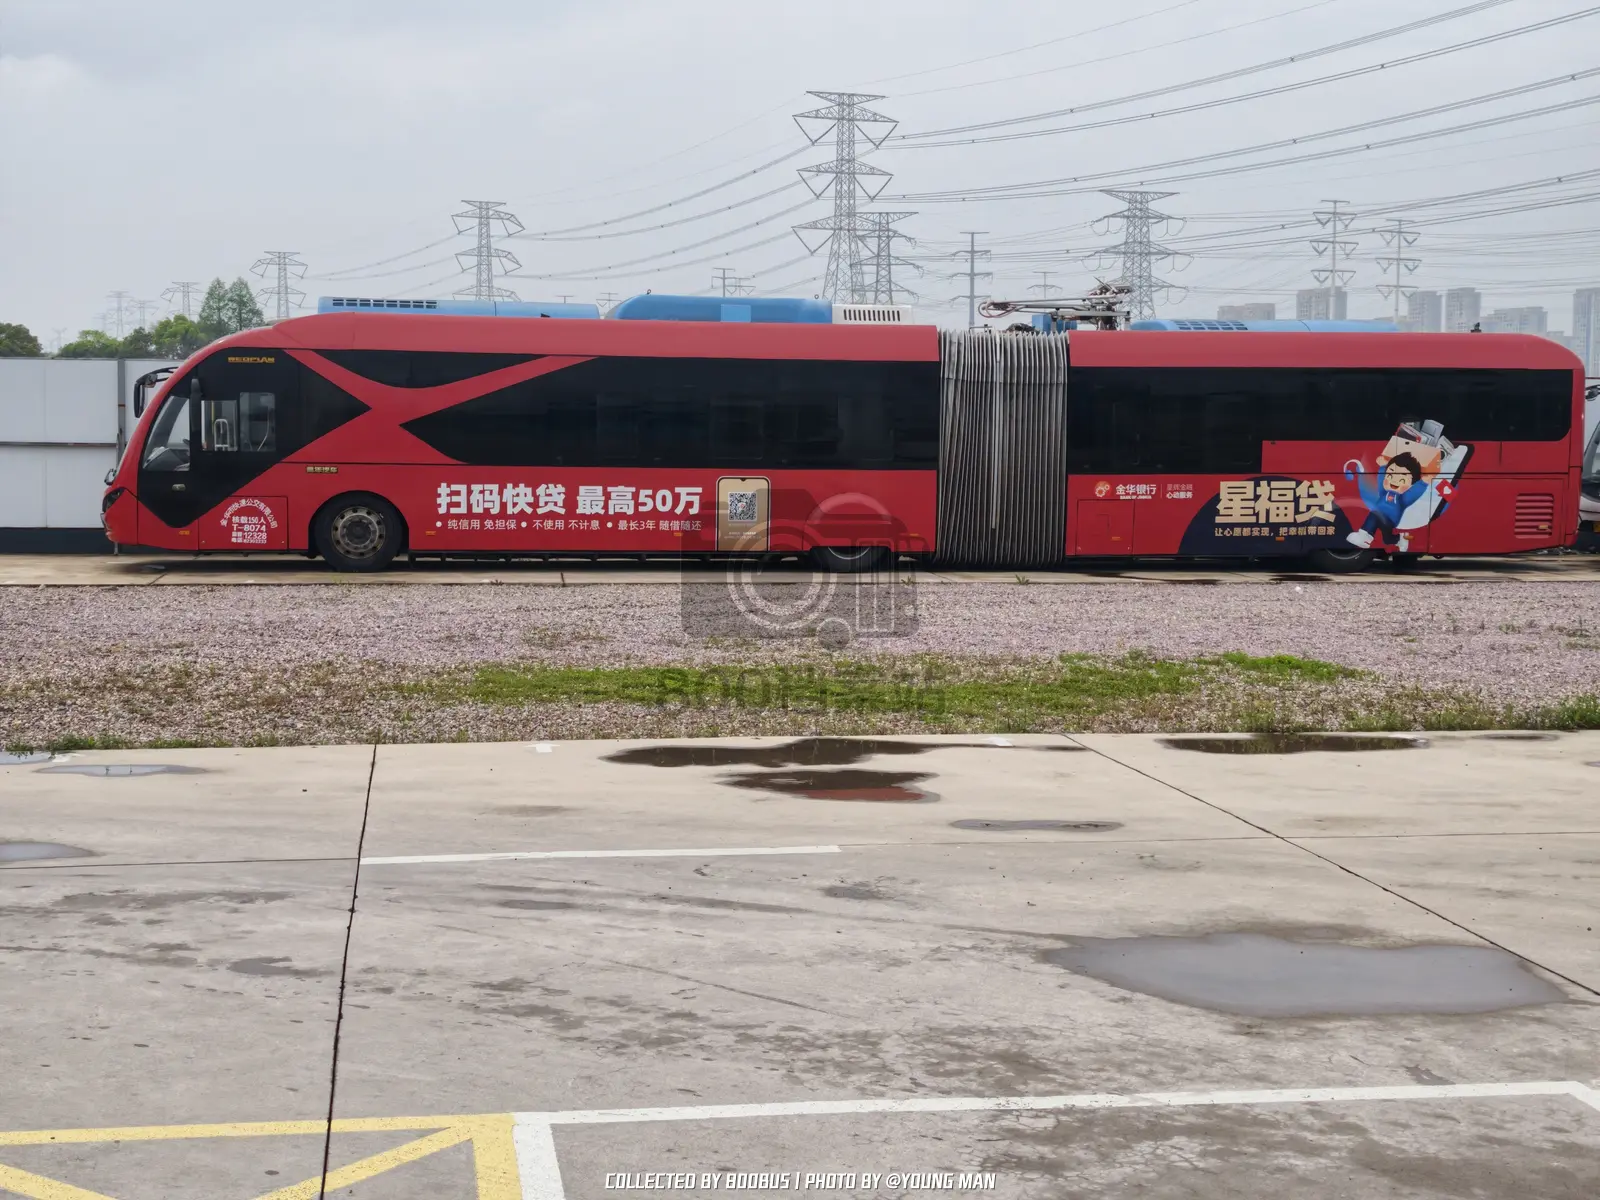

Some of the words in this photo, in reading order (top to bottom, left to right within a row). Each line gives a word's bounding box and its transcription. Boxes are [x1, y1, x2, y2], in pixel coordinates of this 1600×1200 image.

[1116, 484, 1157, 495] 金华银行
[437, 483, 566, 514] 扫码快贷
[576, 485, 702, 515] 最高50万
[1215, 480, 1336, 523] 星福贷
[447, 519, 480, 530] 纯信用
[484, 519, 517, 530] 免担保
[532, 520, 565, 530] 不使用
[568, 520, 600, 530] 不计息
[618, 520, 656, 530] 最长3年
[659, 520, 702, 531] 随借随还
[243, 532, 267, 540] 12328
